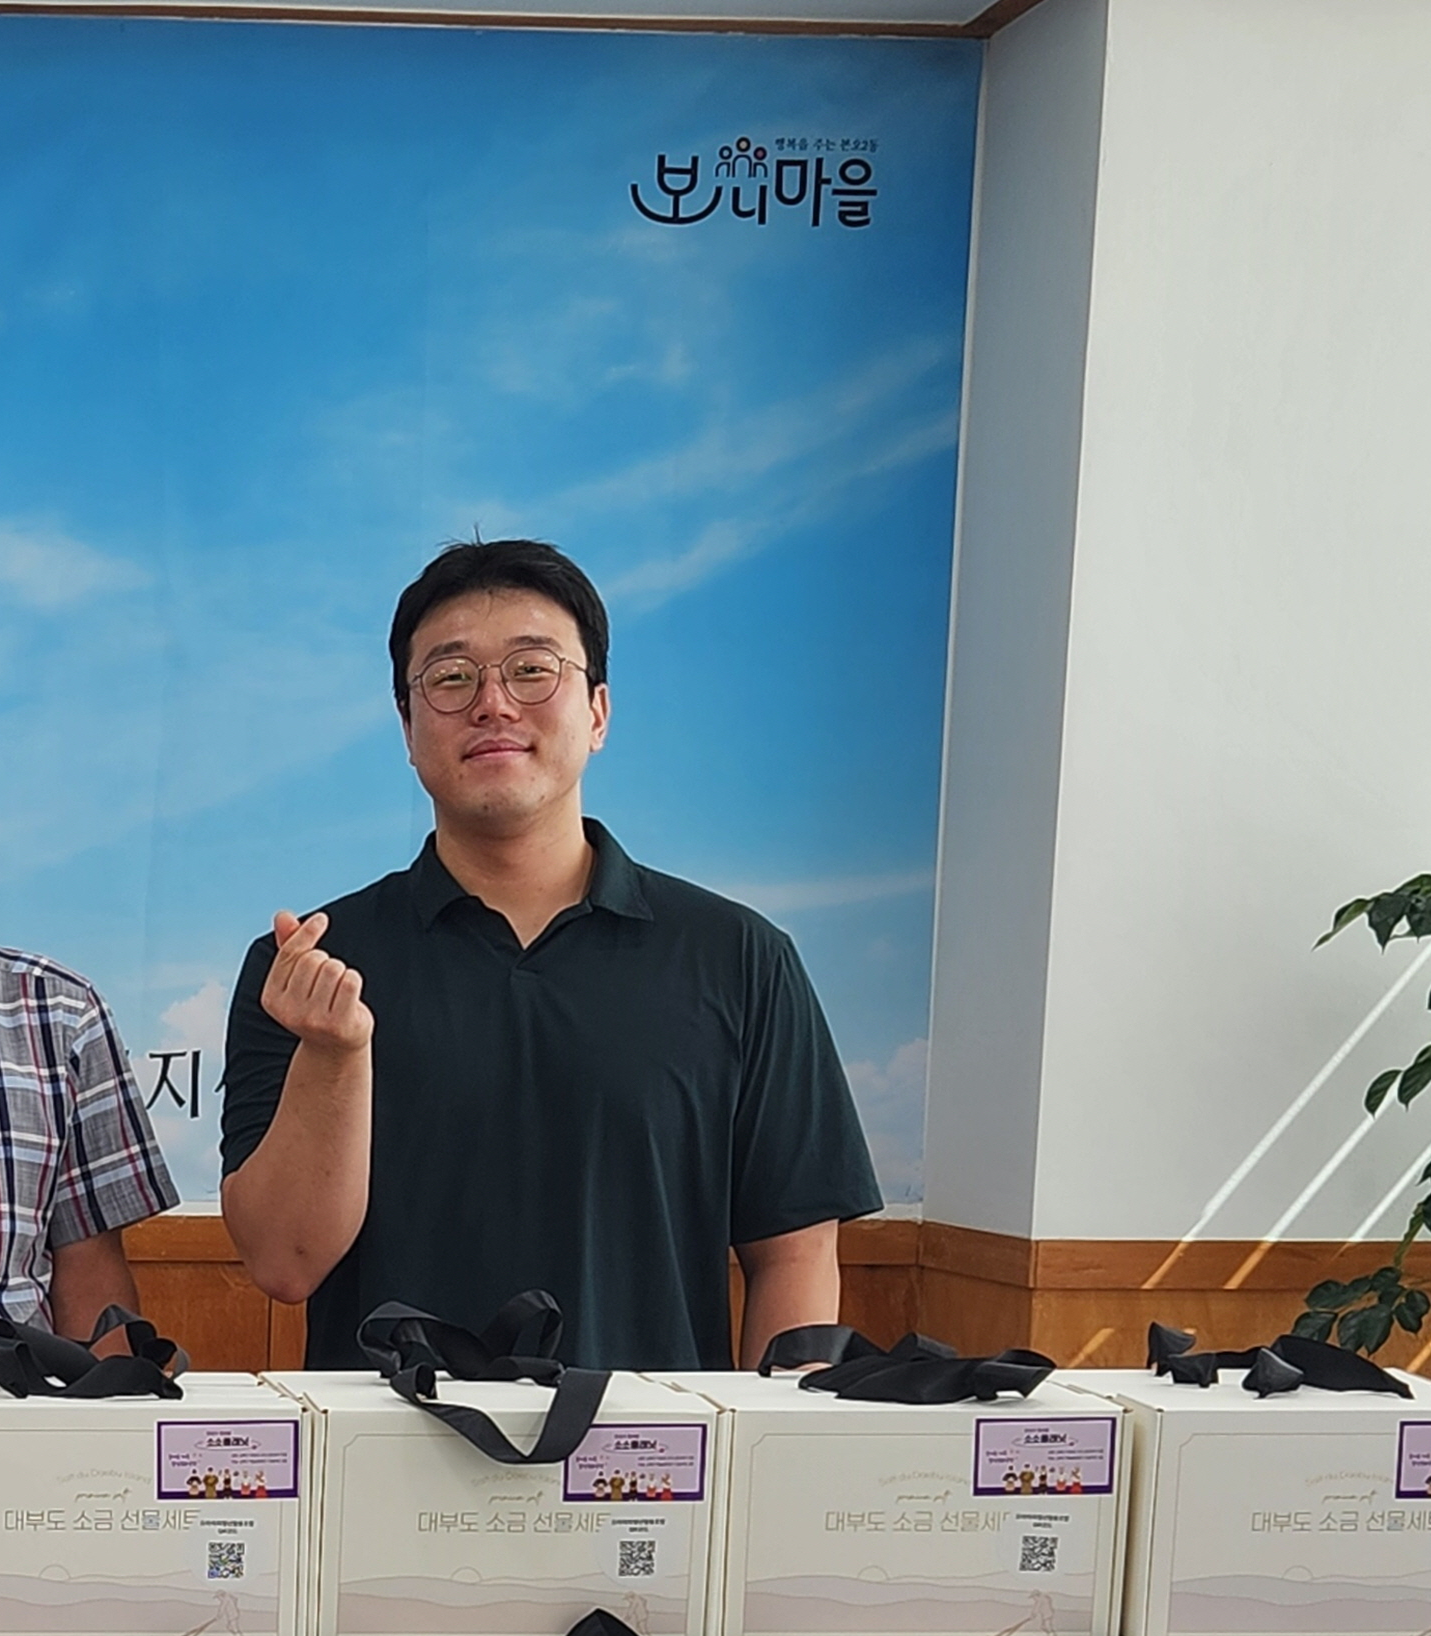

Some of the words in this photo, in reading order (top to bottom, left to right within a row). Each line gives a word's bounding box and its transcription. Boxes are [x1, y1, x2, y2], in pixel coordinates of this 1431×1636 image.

[629, 153, 878, 228] 보니마을
[4, 1509, 67, 1532] 대부도
[72, 1509, 115, 1532] 소금
[417, 1511, 480, 1534] 대부도
[485, 1511, 527, 1534] 소금
[825, 1510, 887, 1533] 대부도
[892, 1510, 935, 1533] 소금
[939, 1510, 1011, 1533] 선물세
[1251, 1510, 1313, 1533] 대부도
[1318, 1511, 1360, 1533] 소금
[1365, 1510, 1431, 1533] 선물세
